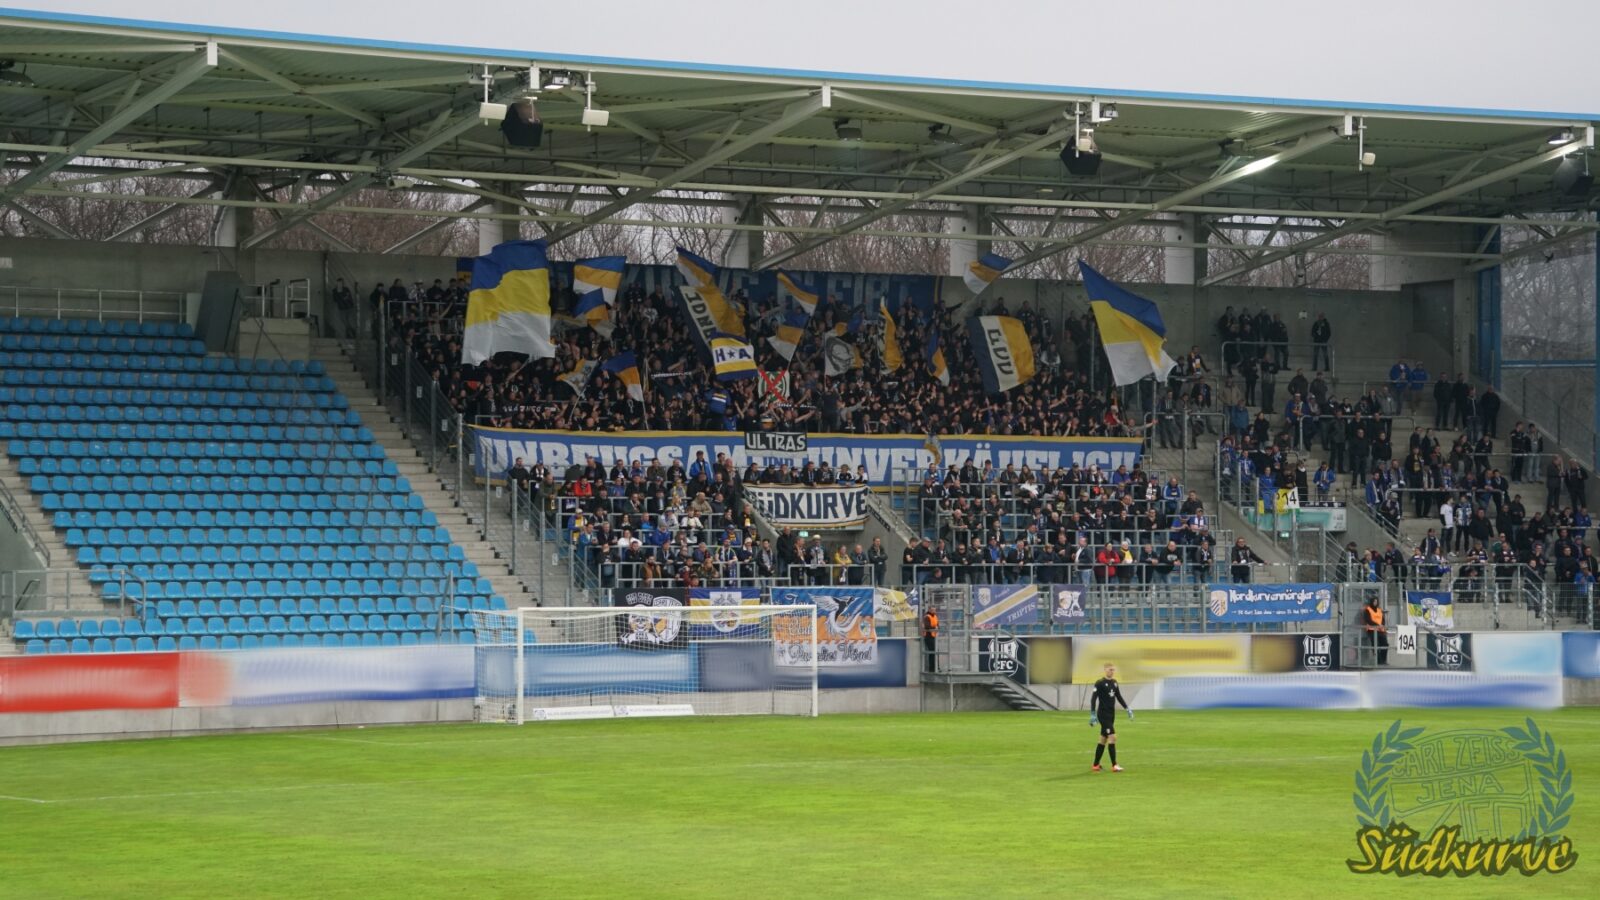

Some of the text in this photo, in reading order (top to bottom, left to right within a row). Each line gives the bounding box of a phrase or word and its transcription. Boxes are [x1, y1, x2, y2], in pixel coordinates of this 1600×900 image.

[746, 432, 806, 452] ULTRAS
[1006, 601, 1036, 623] TRIPTIS
[1398, 634, 1415, 650] 19A
[992, 660, 1014, 670] CFC
[1307, 655, 1327, 665] CFC
